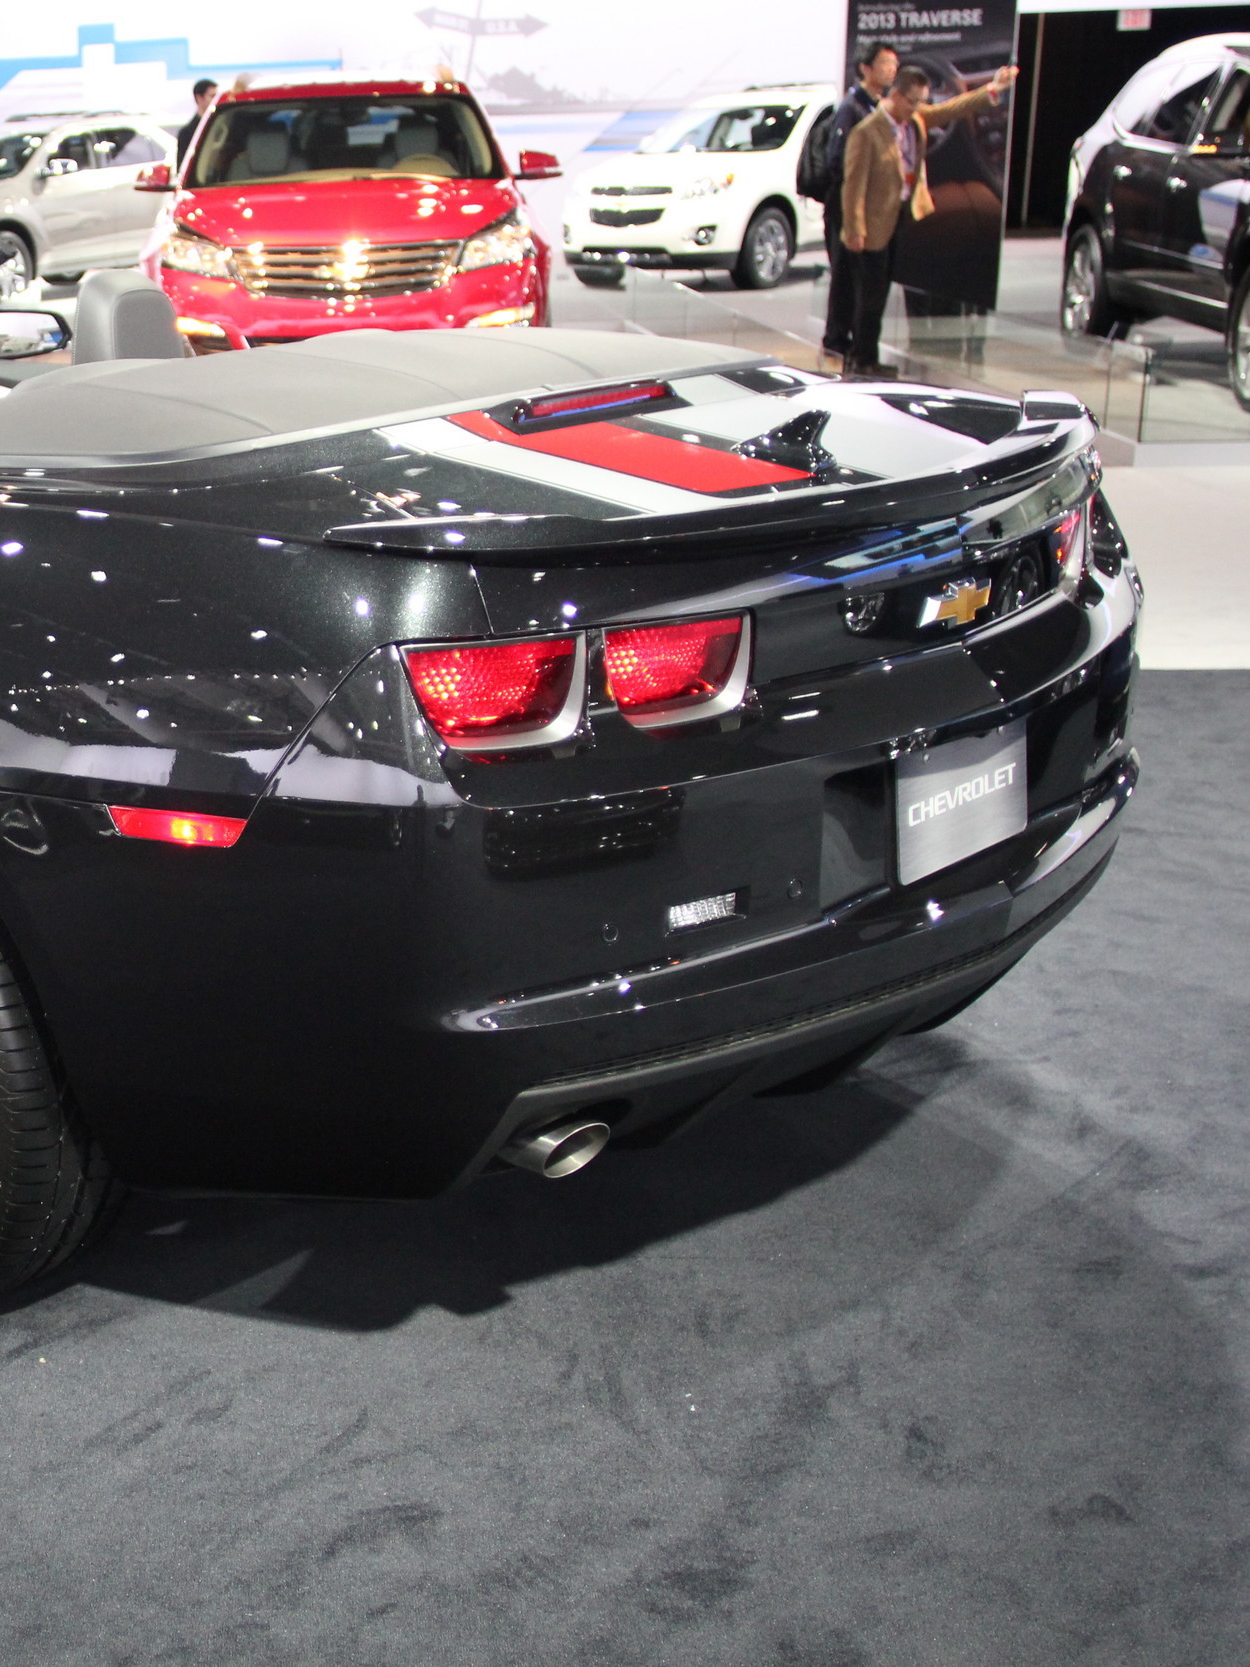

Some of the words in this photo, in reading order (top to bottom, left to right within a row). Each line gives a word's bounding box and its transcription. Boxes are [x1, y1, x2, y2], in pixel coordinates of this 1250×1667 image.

[857, 11, 896, 30] 2013
[900, 8, 983, 29] TRAVERSE
[908, 762, 1017, 827] CHEVROLET
